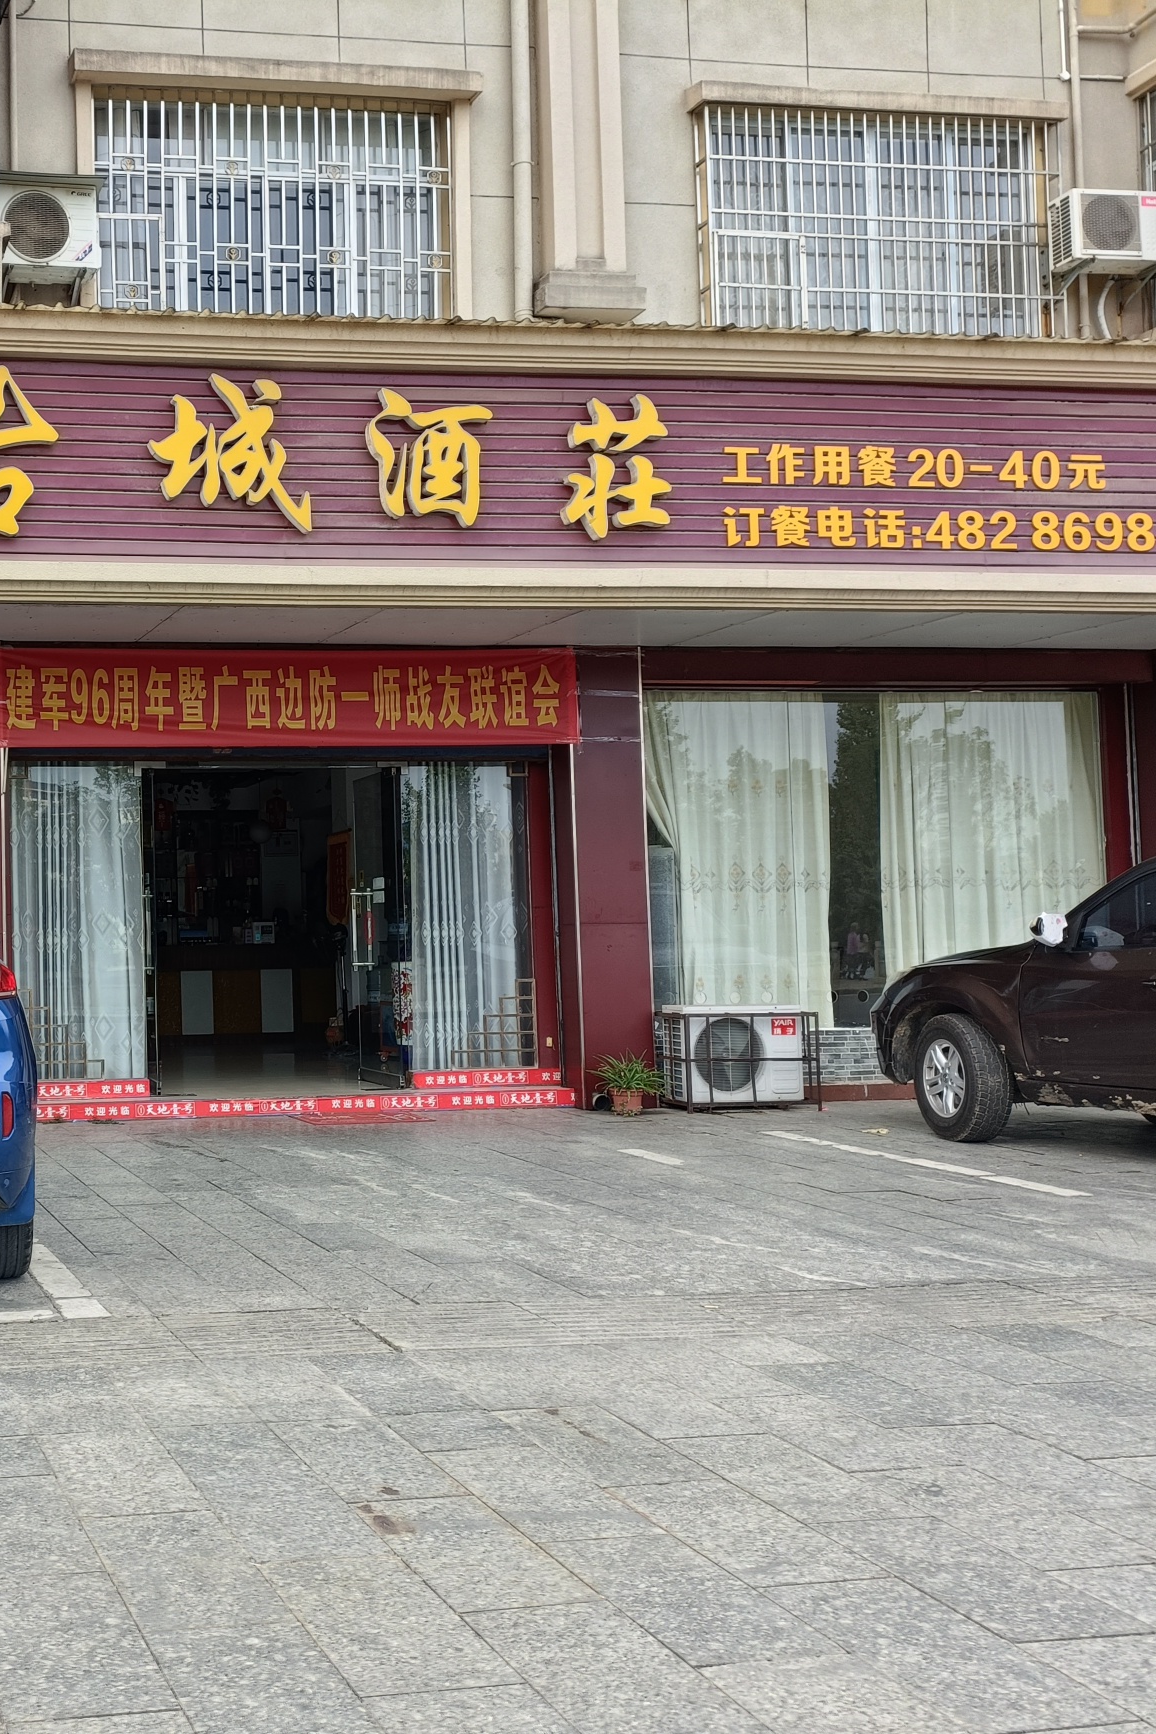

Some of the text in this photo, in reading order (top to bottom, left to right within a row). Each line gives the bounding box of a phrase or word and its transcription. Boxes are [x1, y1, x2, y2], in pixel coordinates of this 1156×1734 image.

[722, 443, 1107, 491] 工作用餐20-40元
[1032, 510, 1155, 552] 8698
[5, 664, 561, 731] 建军96周年暨广西边防一师战友联谊会
[38, 1083, 146, 1097] 天地壹号 欢迎光临
[425, 1075, 468, 1085] 欢迎光临
[482, 1071, 528, 1084] 天地壹号
[84, 1105, 130, 1117] 欢迎光临
[146, 1103, 194, 1116] 天地壹号
[209, 1102, 254, 1113] 欢迎光临
[269, 1099, 317, 1111] 天地壹号
[331, 1098, 375, 1109] 欢迎光临
[391, 1096, 437, 1108] 天地壹号
[451, 1095, 495, 1106] 欢迎光临
[510, 1091, 556, 1105] 天地壹号
